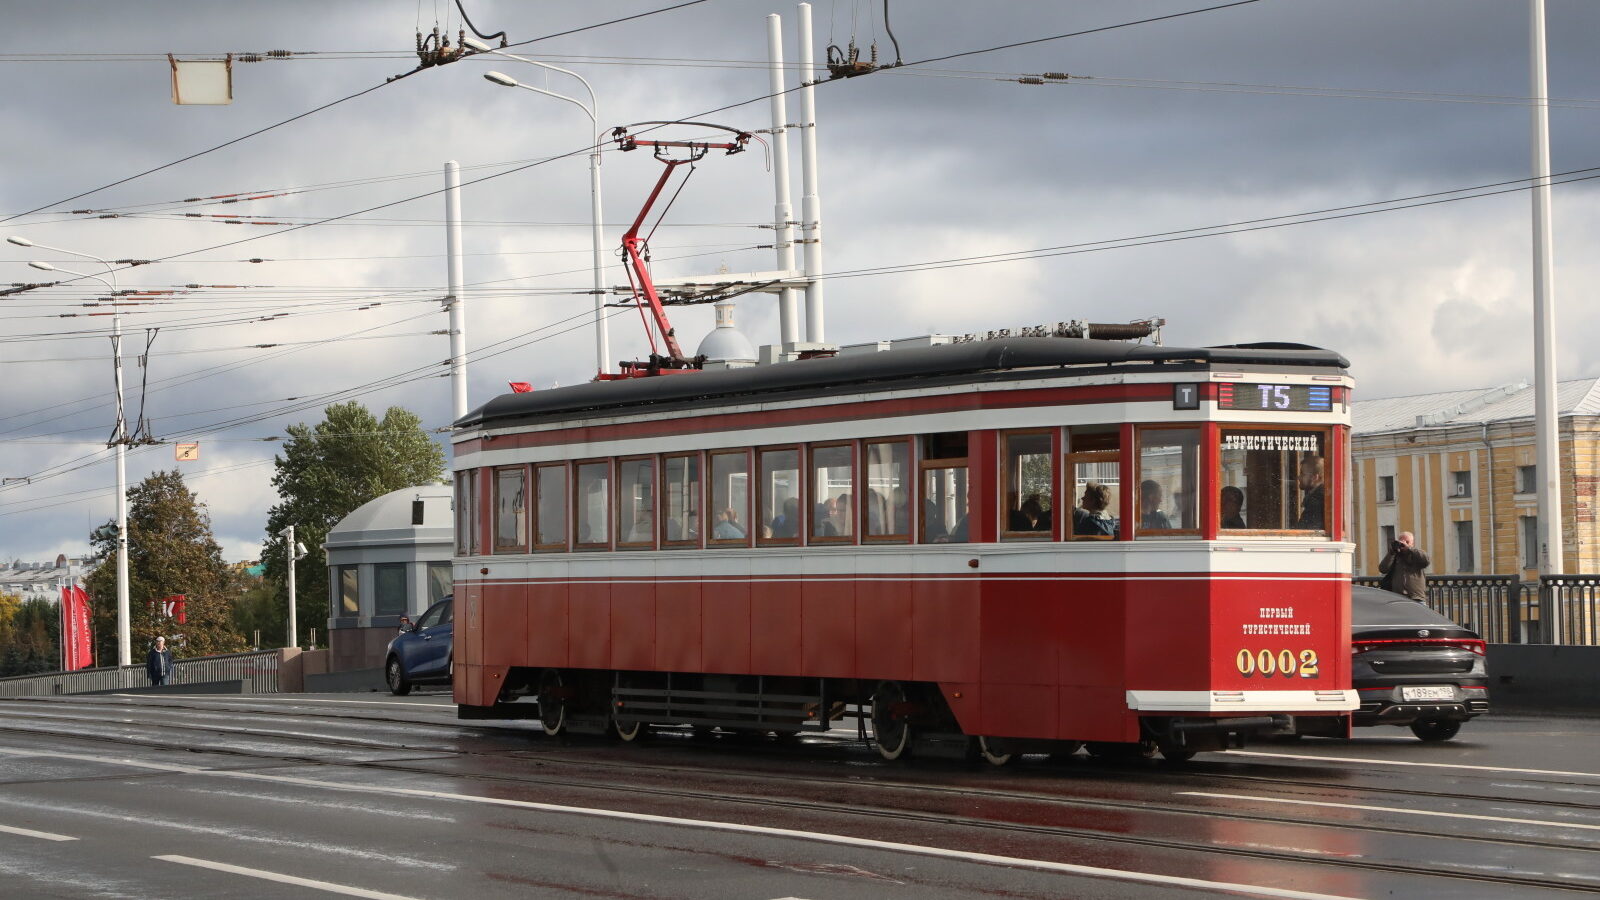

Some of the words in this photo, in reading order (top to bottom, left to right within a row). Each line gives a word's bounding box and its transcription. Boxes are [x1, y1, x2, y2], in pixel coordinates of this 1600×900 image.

[1257, 384, 1290, 409] Т5
[1225, 435, 1317, 451] ТУРИСТИЧЕСКИЙ
[1259, 606, 1294, 619] ПЕРВЫЙ
[1242, 622, 1312, 635] ТУРИСТИЧЕСКИЙ
[1236, 648, 1320, 679] 0002
